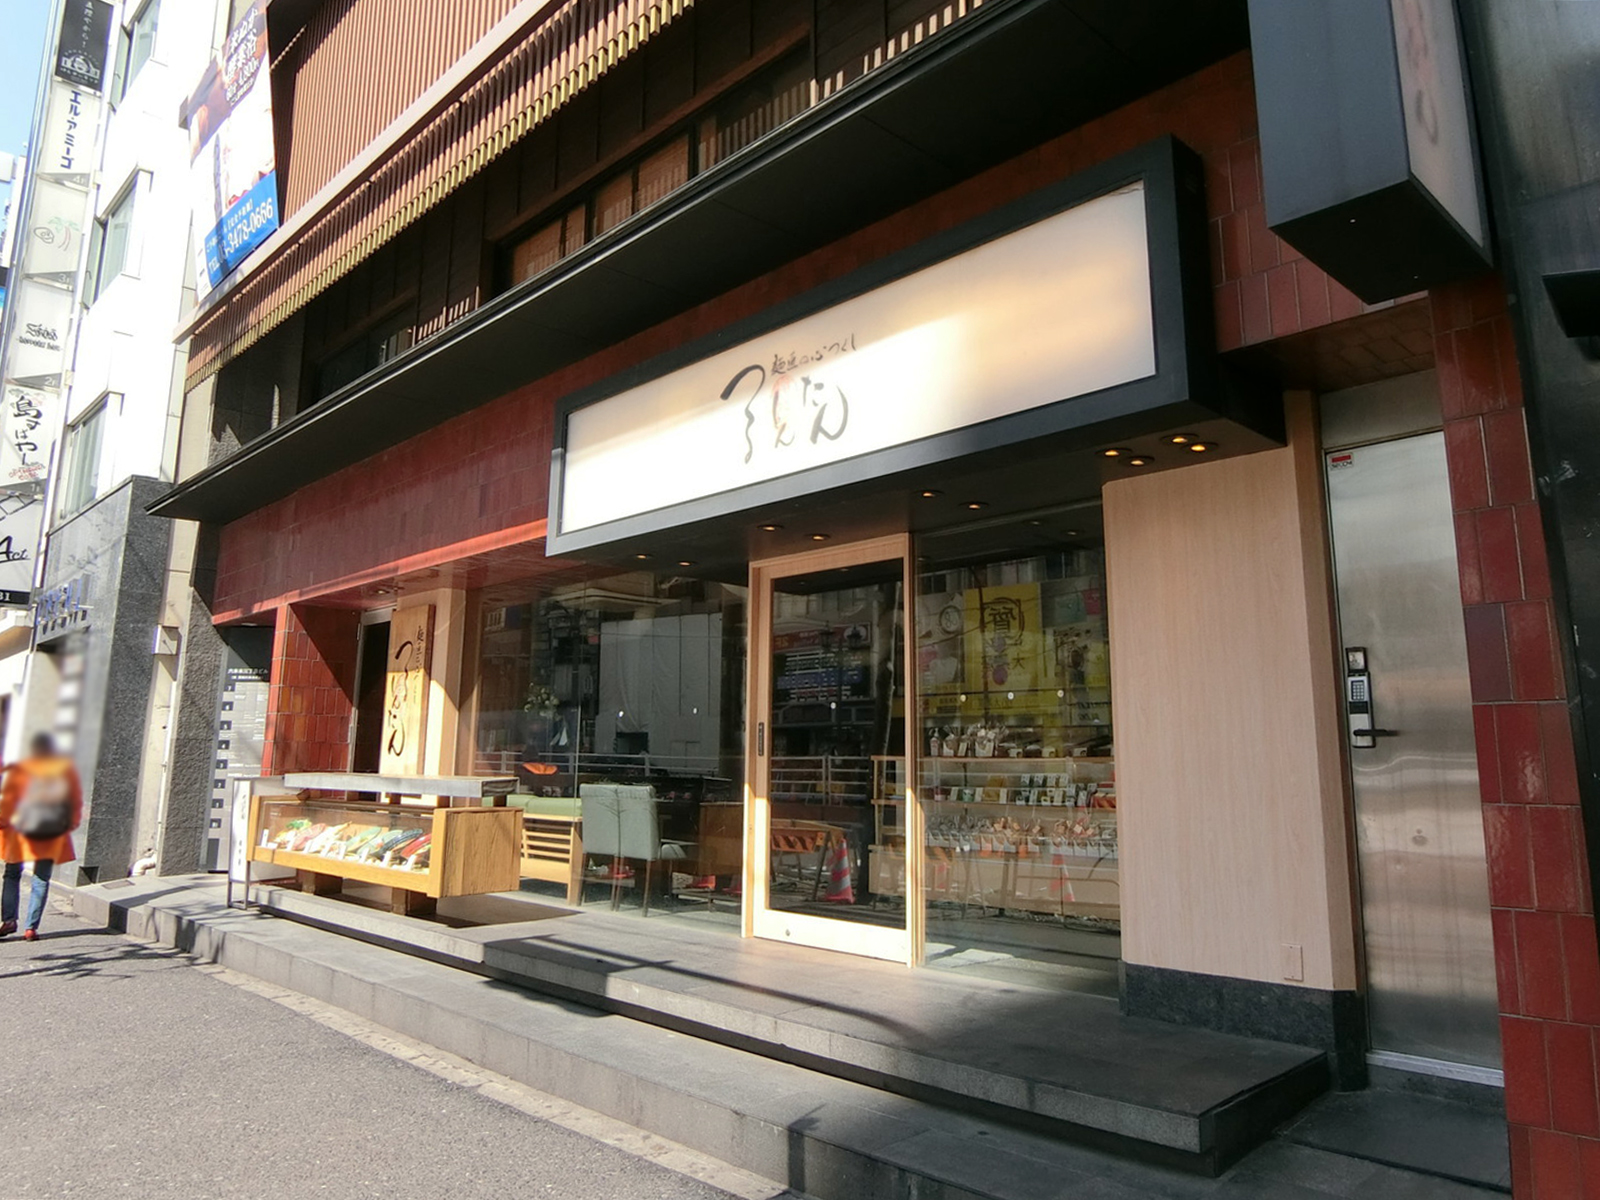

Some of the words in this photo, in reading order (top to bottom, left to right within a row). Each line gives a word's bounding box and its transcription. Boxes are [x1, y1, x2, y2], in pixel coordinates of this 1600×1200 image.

[60, 90, 82, 169] エル・アミーゴ
